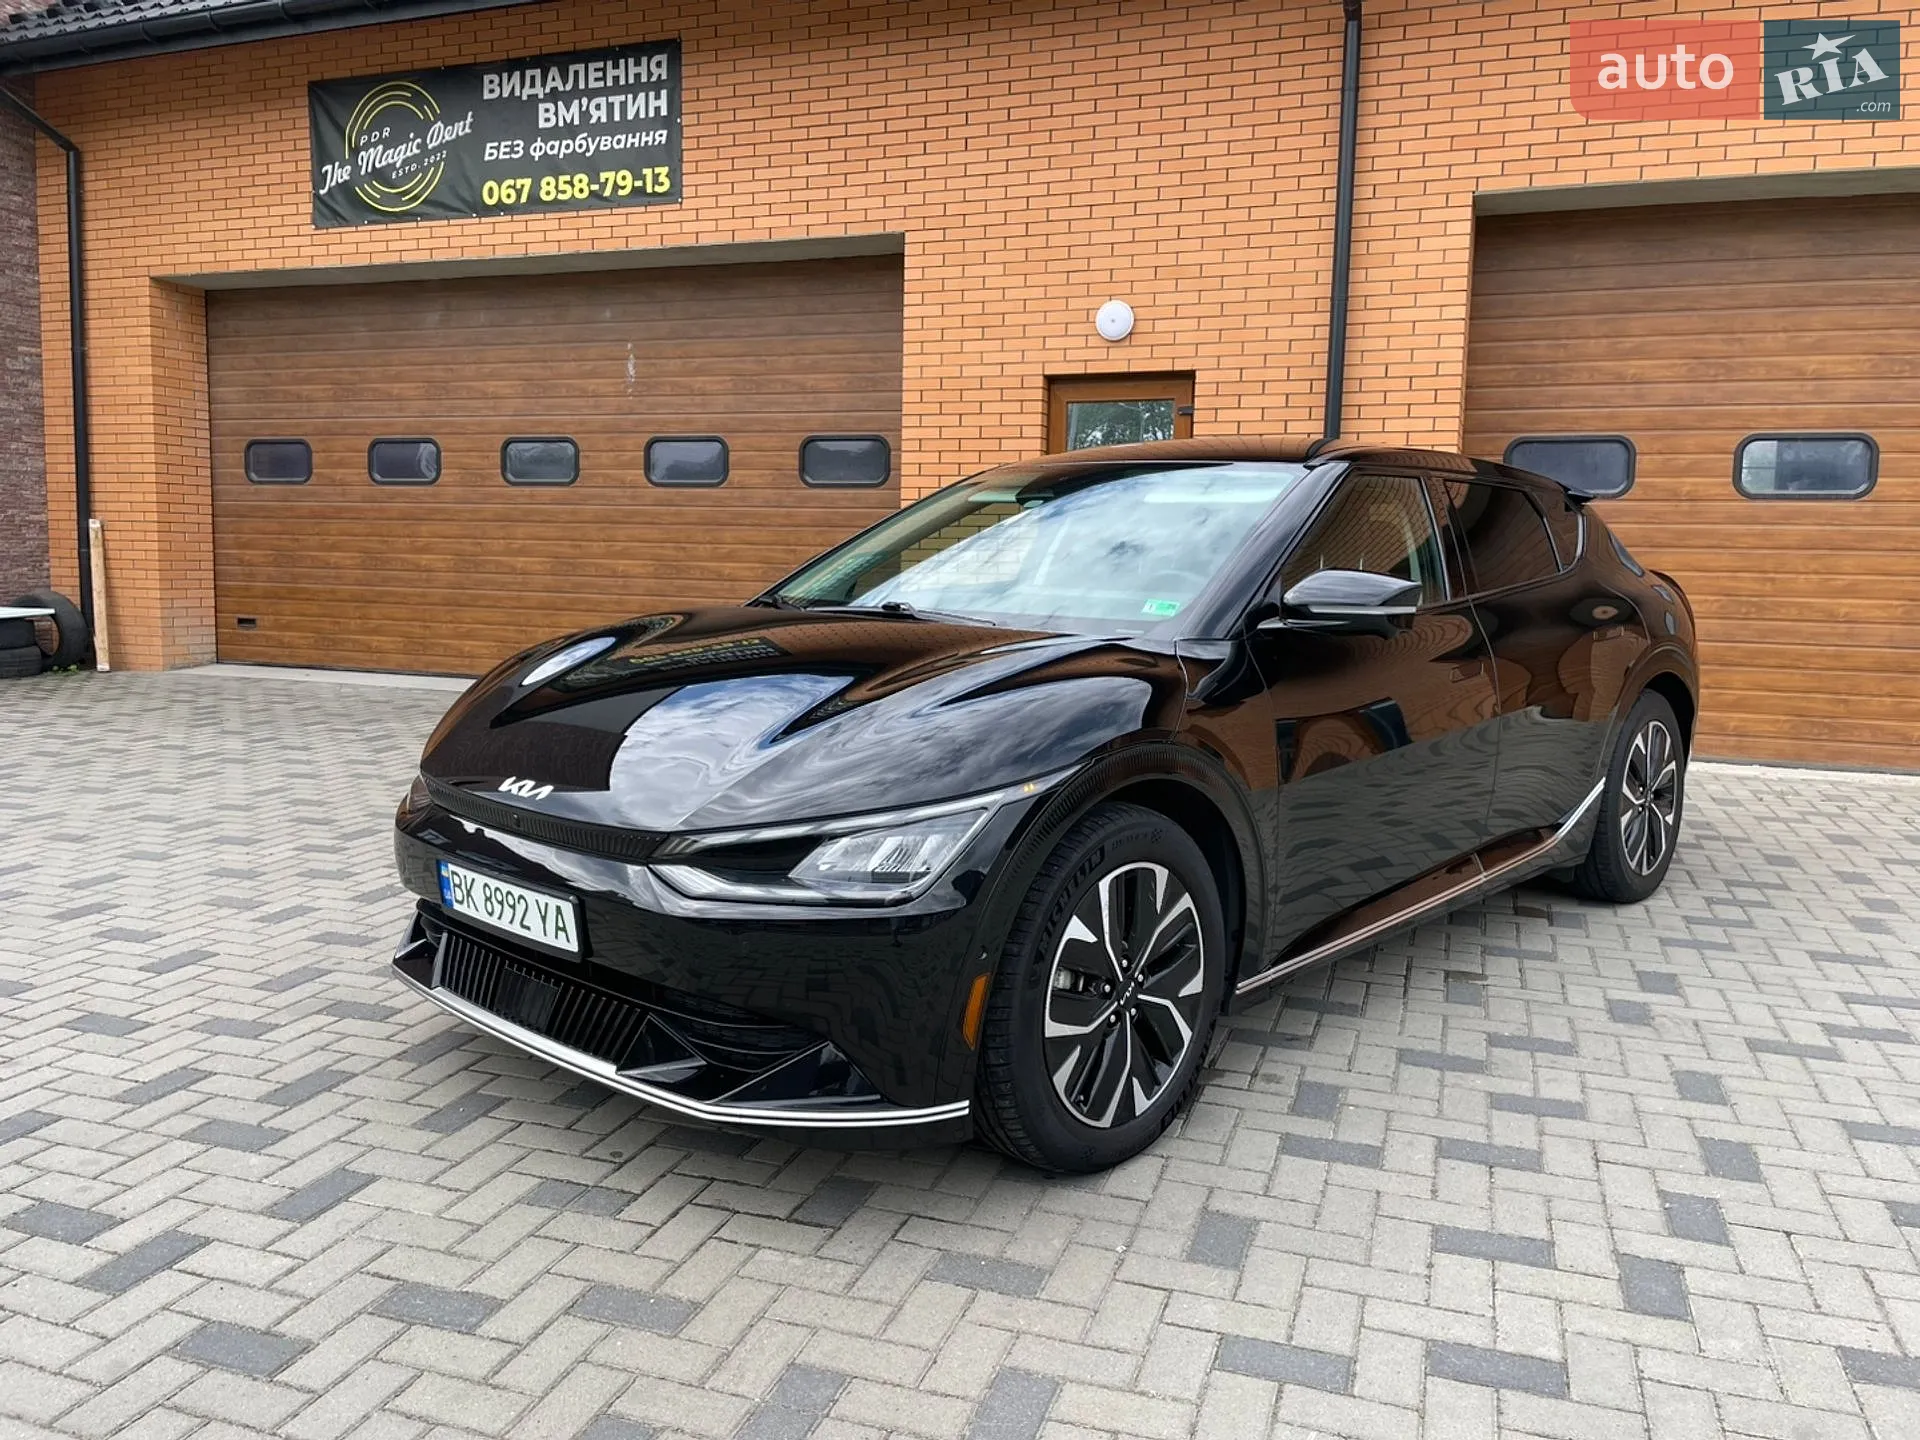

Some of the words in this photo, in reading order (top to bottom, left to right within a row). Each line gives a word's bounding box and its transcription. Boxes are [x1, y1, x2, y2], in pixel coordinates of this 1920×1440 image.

[482, 54, 669, 100] ВИДАЛЕННЯ
[319, 161, 352, 195] The
[358, 132, 423, 175] Magic
[426, 111, 474, 149] Dent
[360, 127, 391, 146] PDR
[484, 140, 524, 162] БЕЗ
[529, 129, 668, 160] фарбування
[482, 178, 532, 206] 067
[539, 166, 671, 201] 858-79-13
[450, 870, 479, 913] BK
[483, 882, 531, 932] 8992
[535, 898, 571, 944] YA
